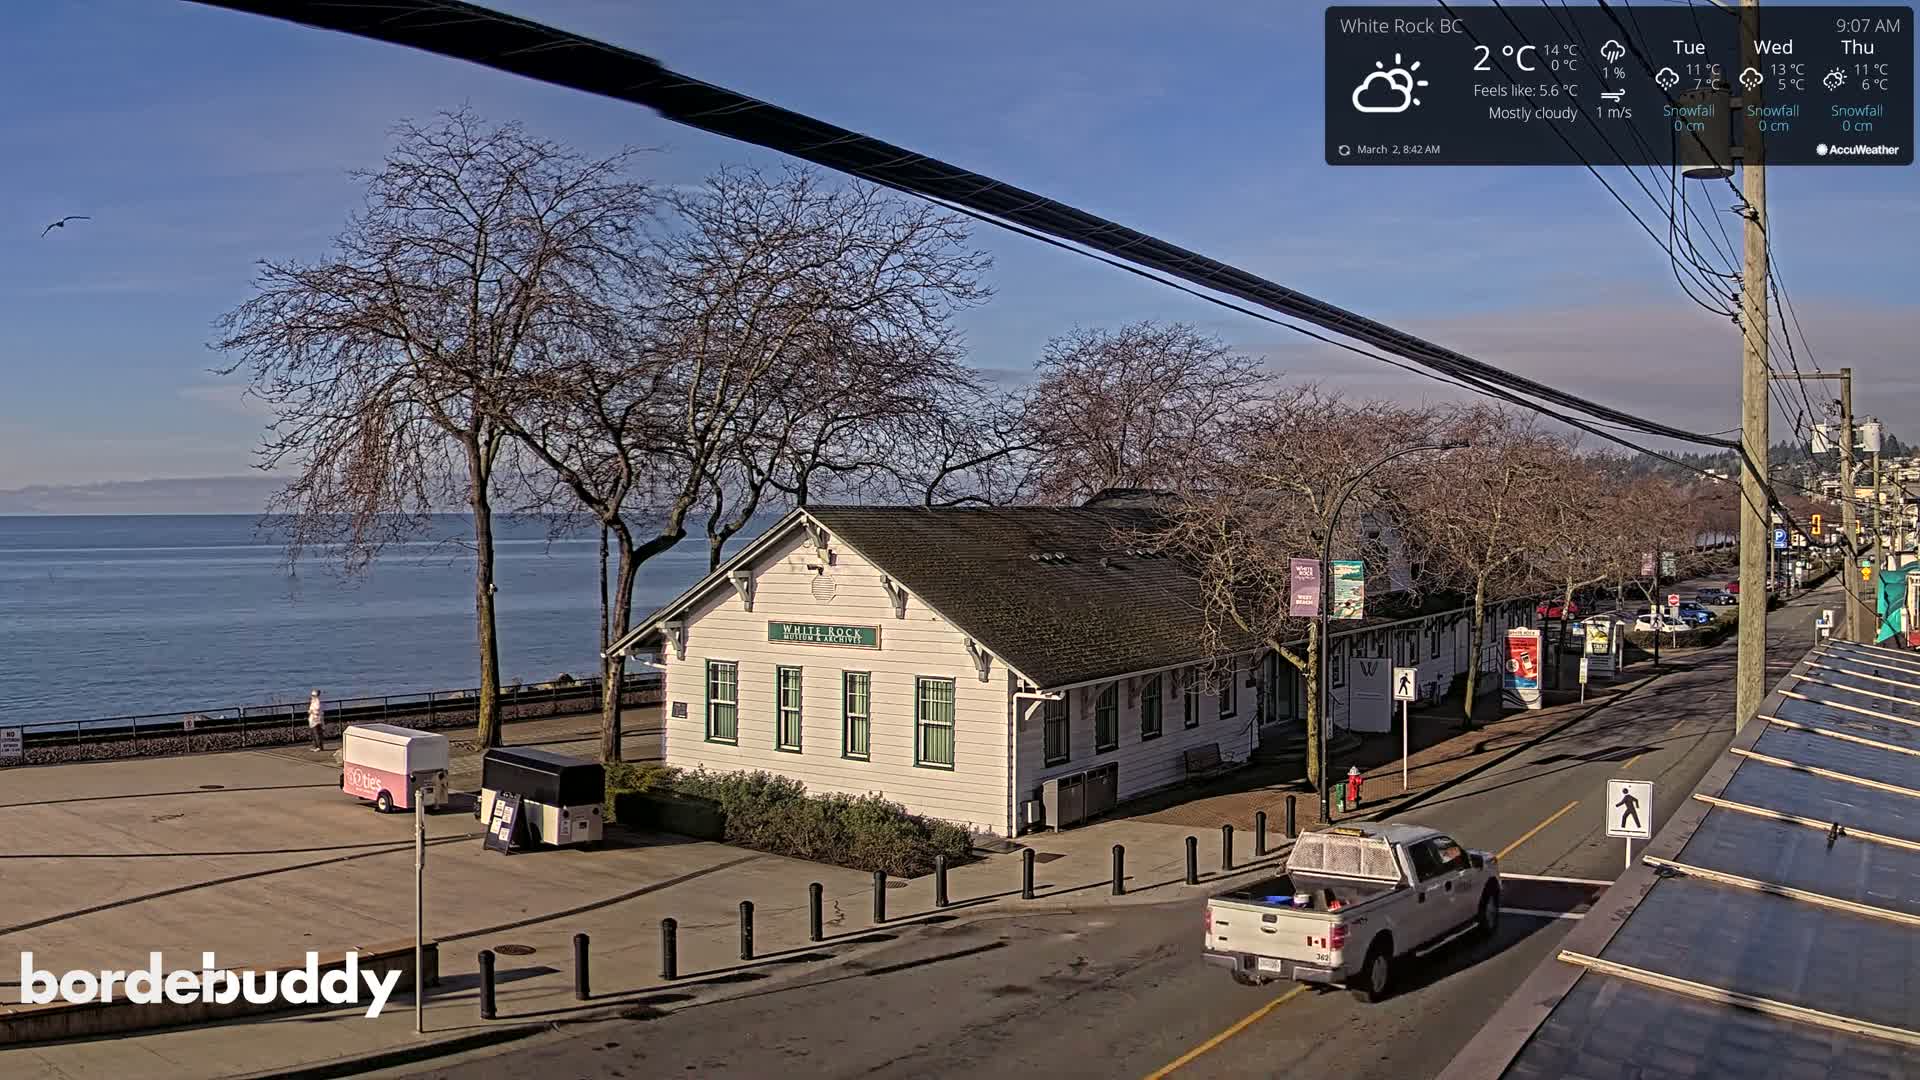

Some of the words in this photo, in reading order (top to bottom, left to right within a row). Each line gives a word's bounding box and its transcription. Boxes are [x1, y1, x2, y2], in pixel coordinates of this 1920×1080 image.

[783, 624, 821, 636] WHITE
[828, 626, 861, 638] ROCK
[783, 633, 813, 641] MUSEUM
[823, 635, 862, 644] ARCHIVES
[1316, 953, 1329, 962] 362
